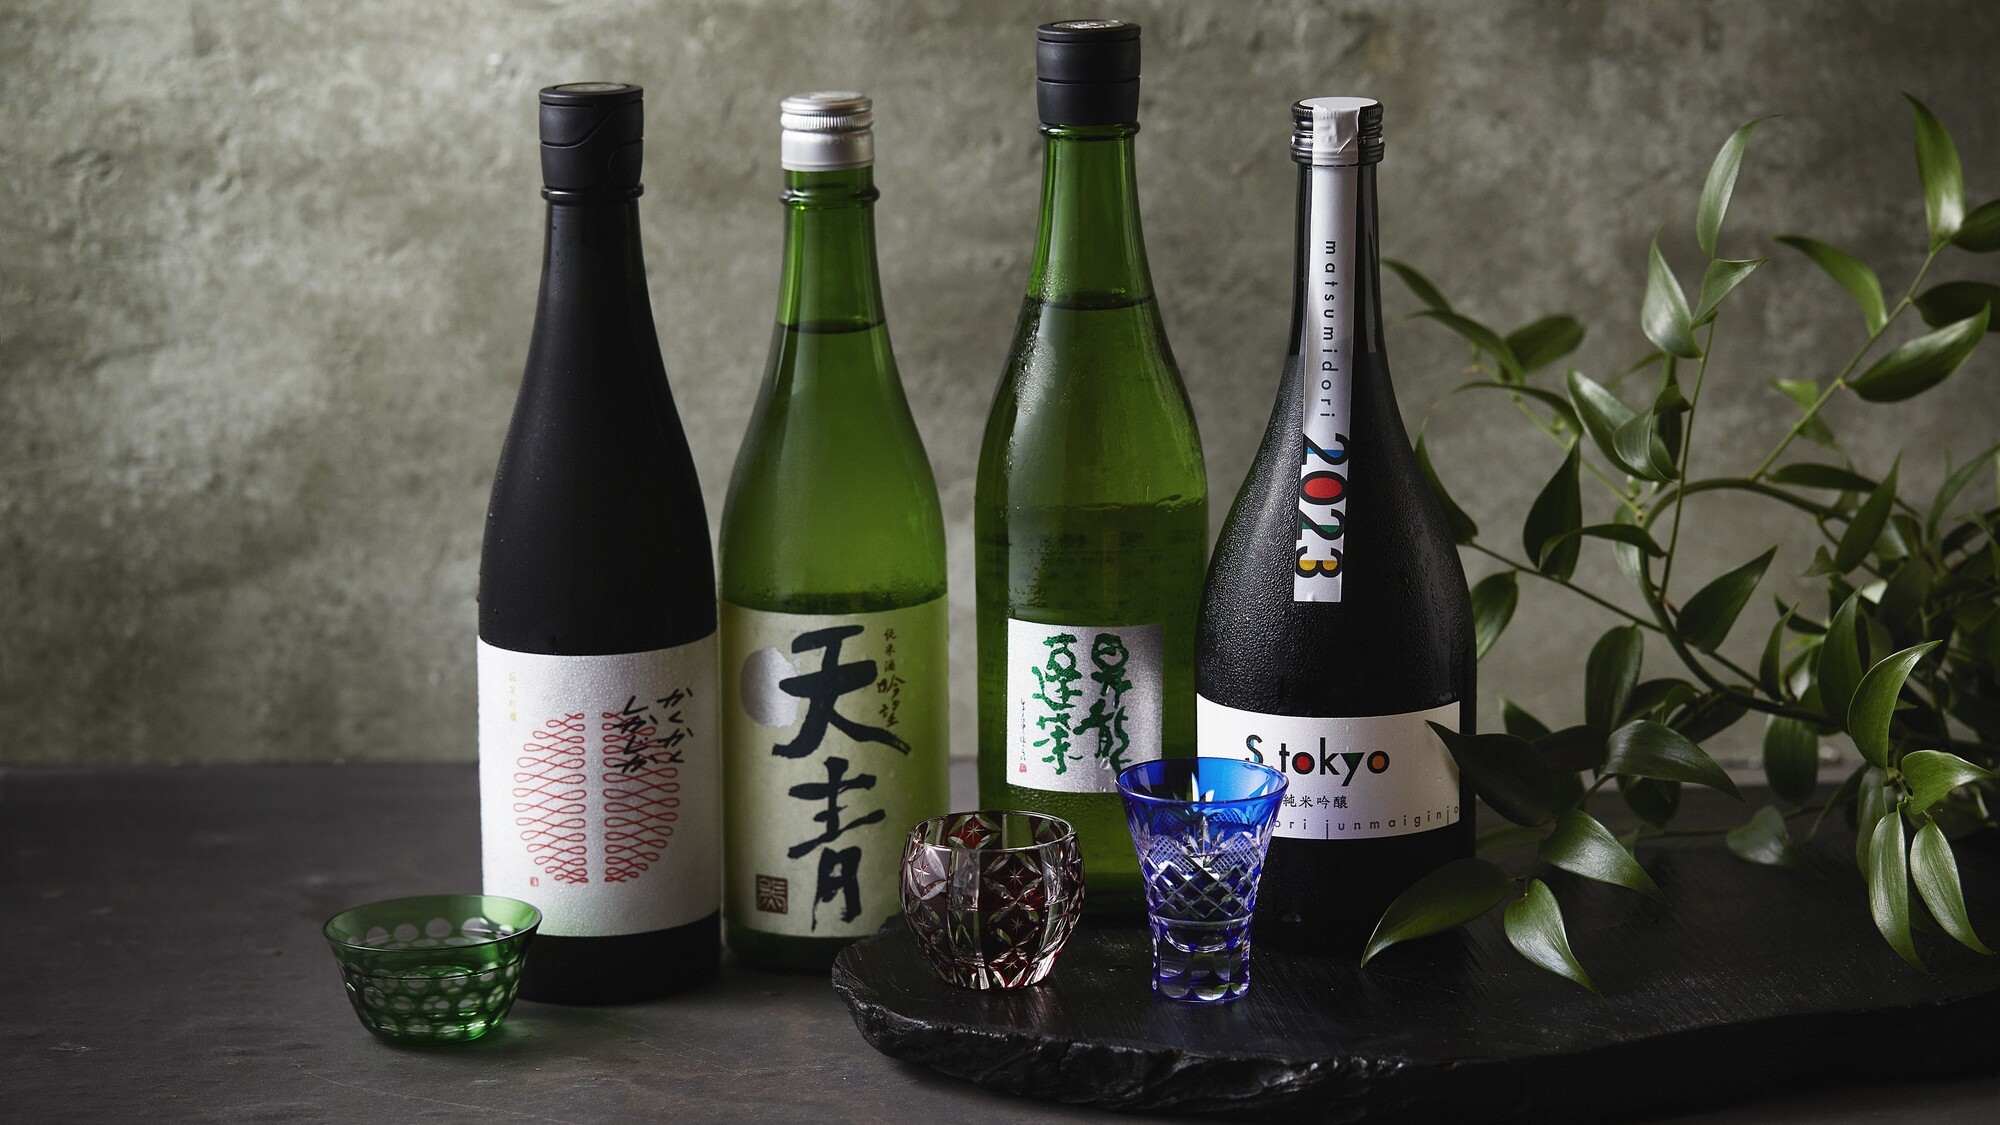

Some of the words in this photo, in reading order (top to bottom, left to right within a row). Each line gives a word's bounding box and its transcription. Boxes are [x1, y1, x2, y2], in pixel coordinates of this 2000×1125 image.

[1320, 240, 1338, 418] matsumidori
[1296, 433, 1349, 578] 2023
[772, 625, 912, 933] 天青
[1245, 735, 1265, 764] S
[1279, 737, 1390, 787] tokyo
[1325, 805, 1459, 840] junmaiginjo
